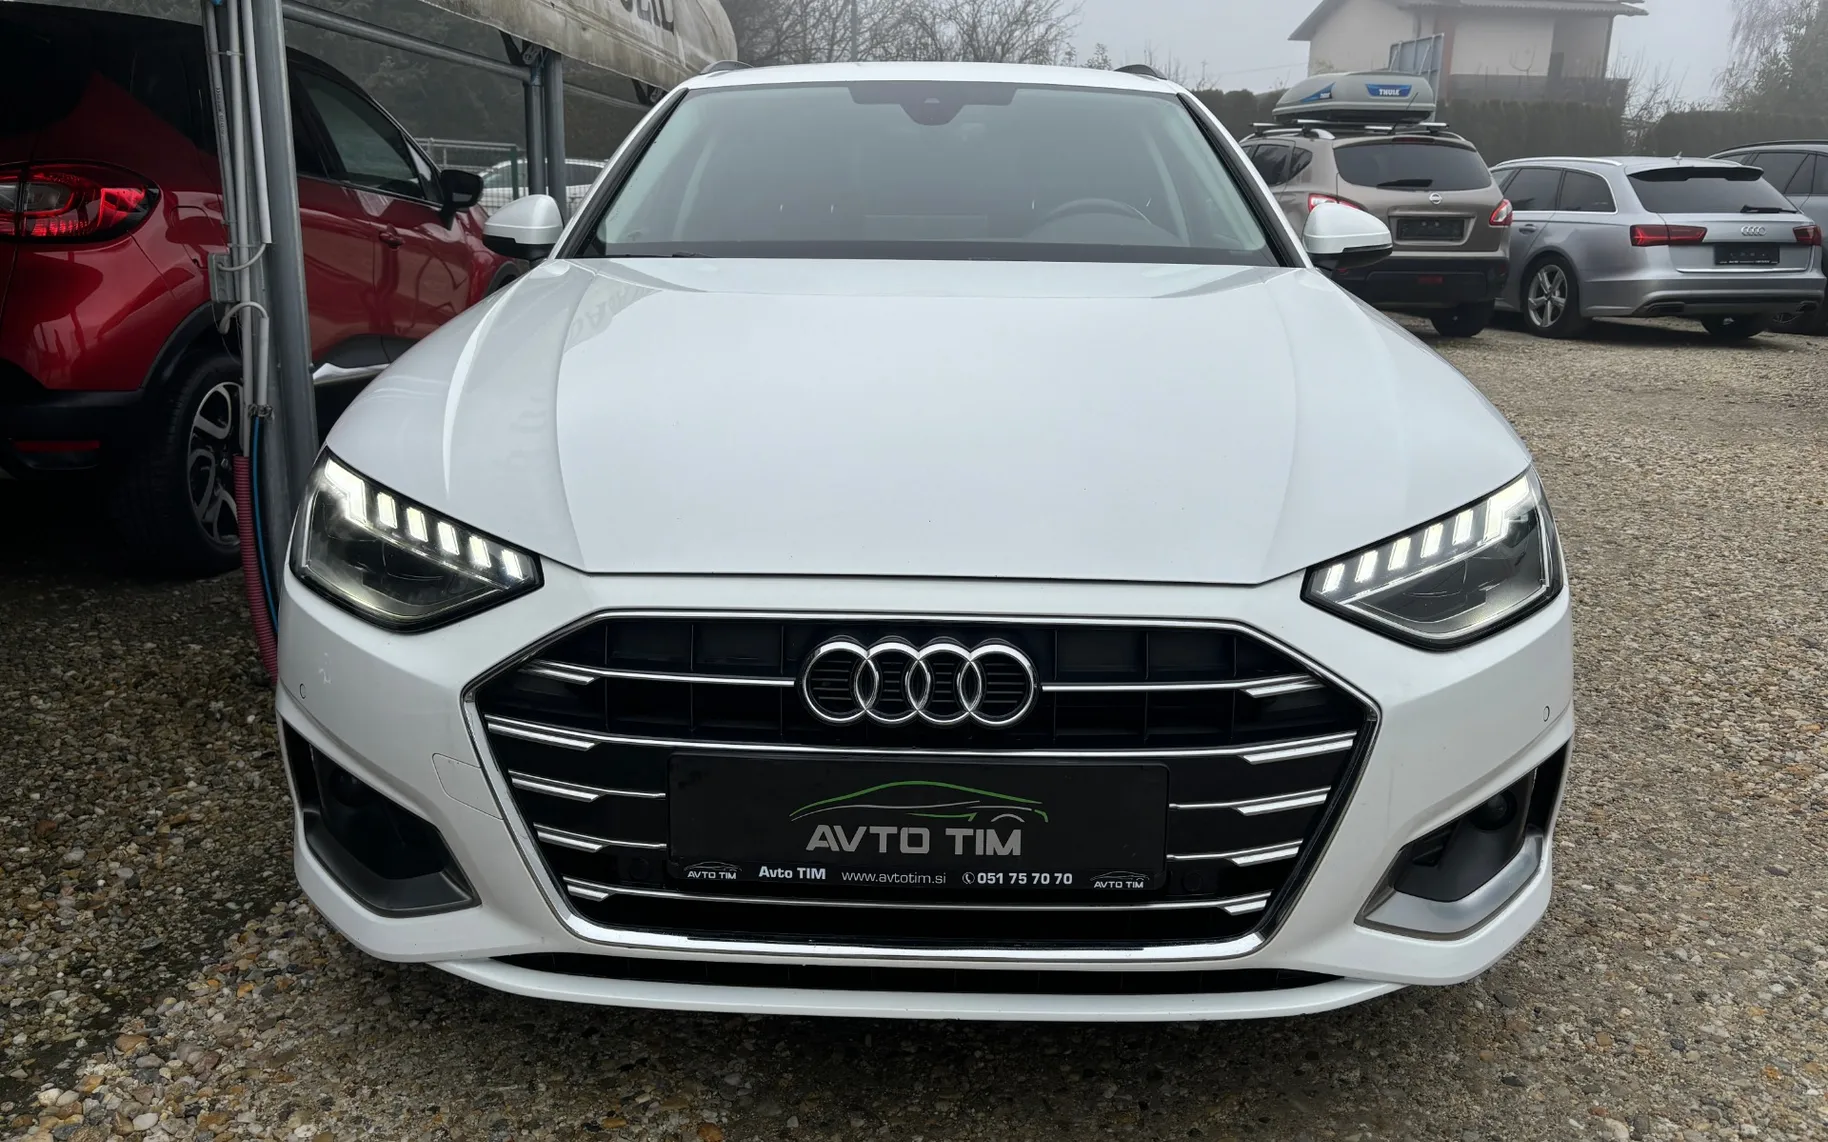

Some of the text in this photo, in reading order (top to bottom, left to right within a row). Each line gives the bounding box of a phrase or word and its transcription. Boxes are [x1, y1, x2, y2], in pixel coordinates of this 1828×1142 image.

[1379, 88, 1400, 96] THULE
[805, 824, 1022, 856] AVTO TIM
[687, 871, 737, 880] AVTO TIM
[758, 866, 826, 880] Avto TIM
[841, 871, 947, 884] www.avtotim.si
[977, 872, 1073, 885] 051 75 70 70
[1093, 880, 1144, 889] AVTO TIM
